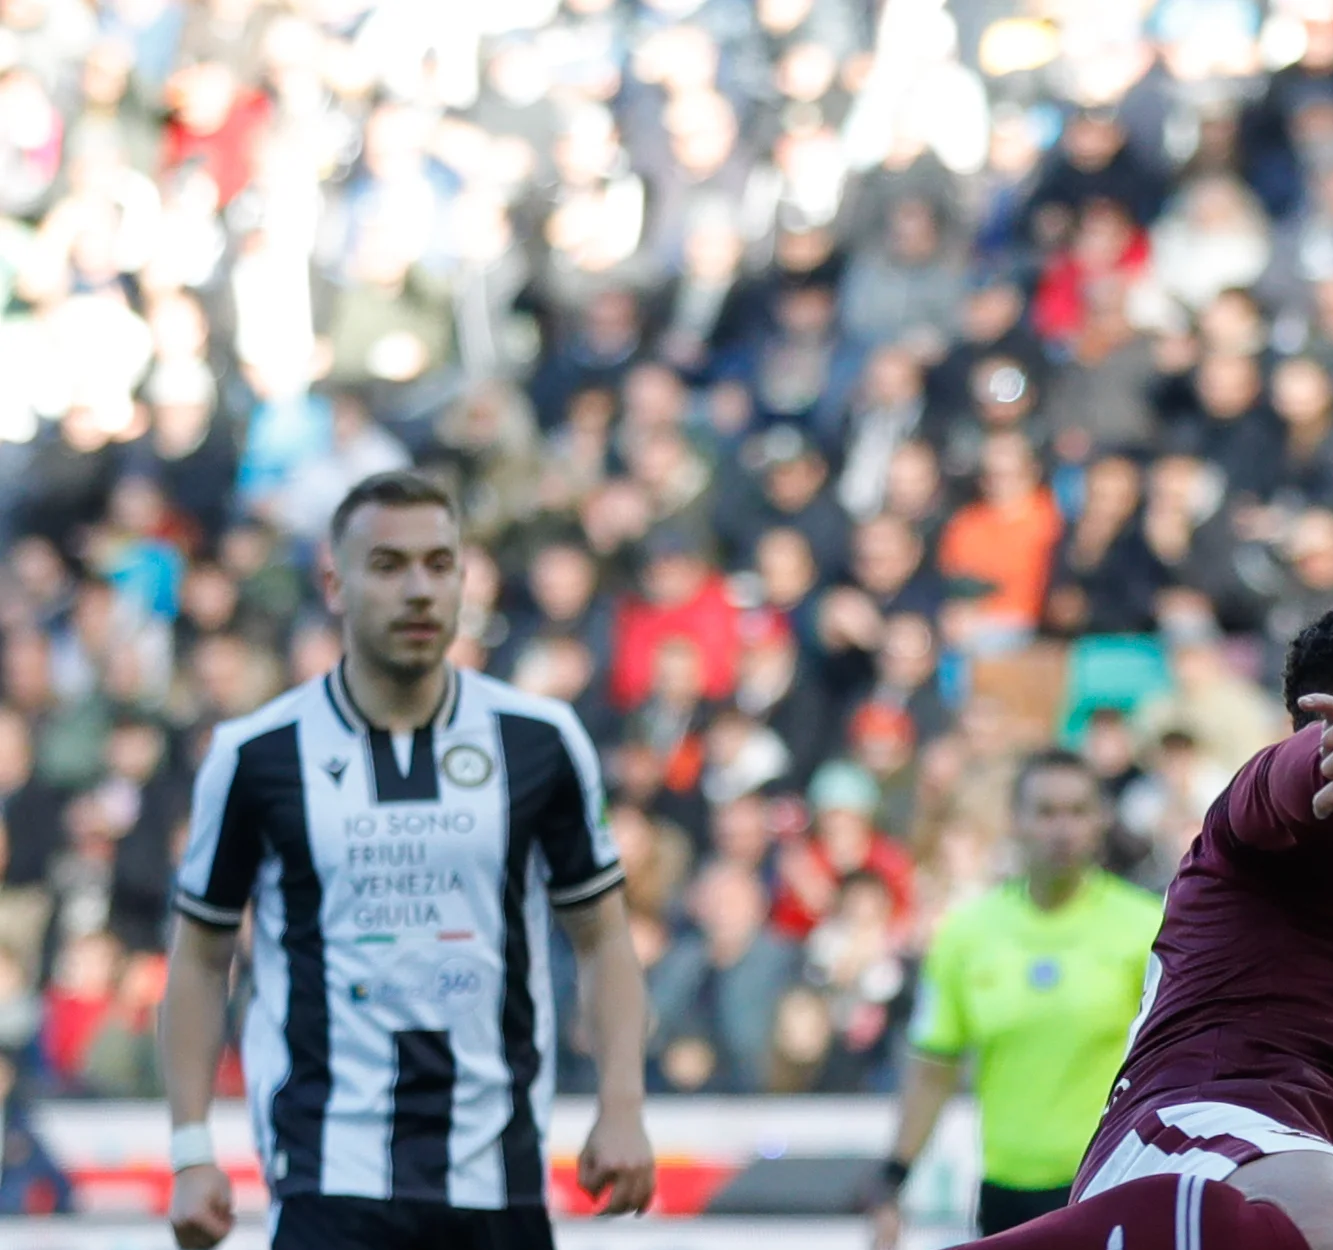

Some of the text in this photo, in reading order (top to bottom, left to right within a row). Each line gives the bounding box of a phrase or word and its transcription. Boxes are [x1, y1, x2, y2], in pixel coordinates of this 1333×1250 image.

[343, 808, 476, 840] IO SONO
[346, 842, 427, 869] FRIULI
[350, 869, 464, 899] VENEZIA
[353, 901, 443, 929] GIULIA
